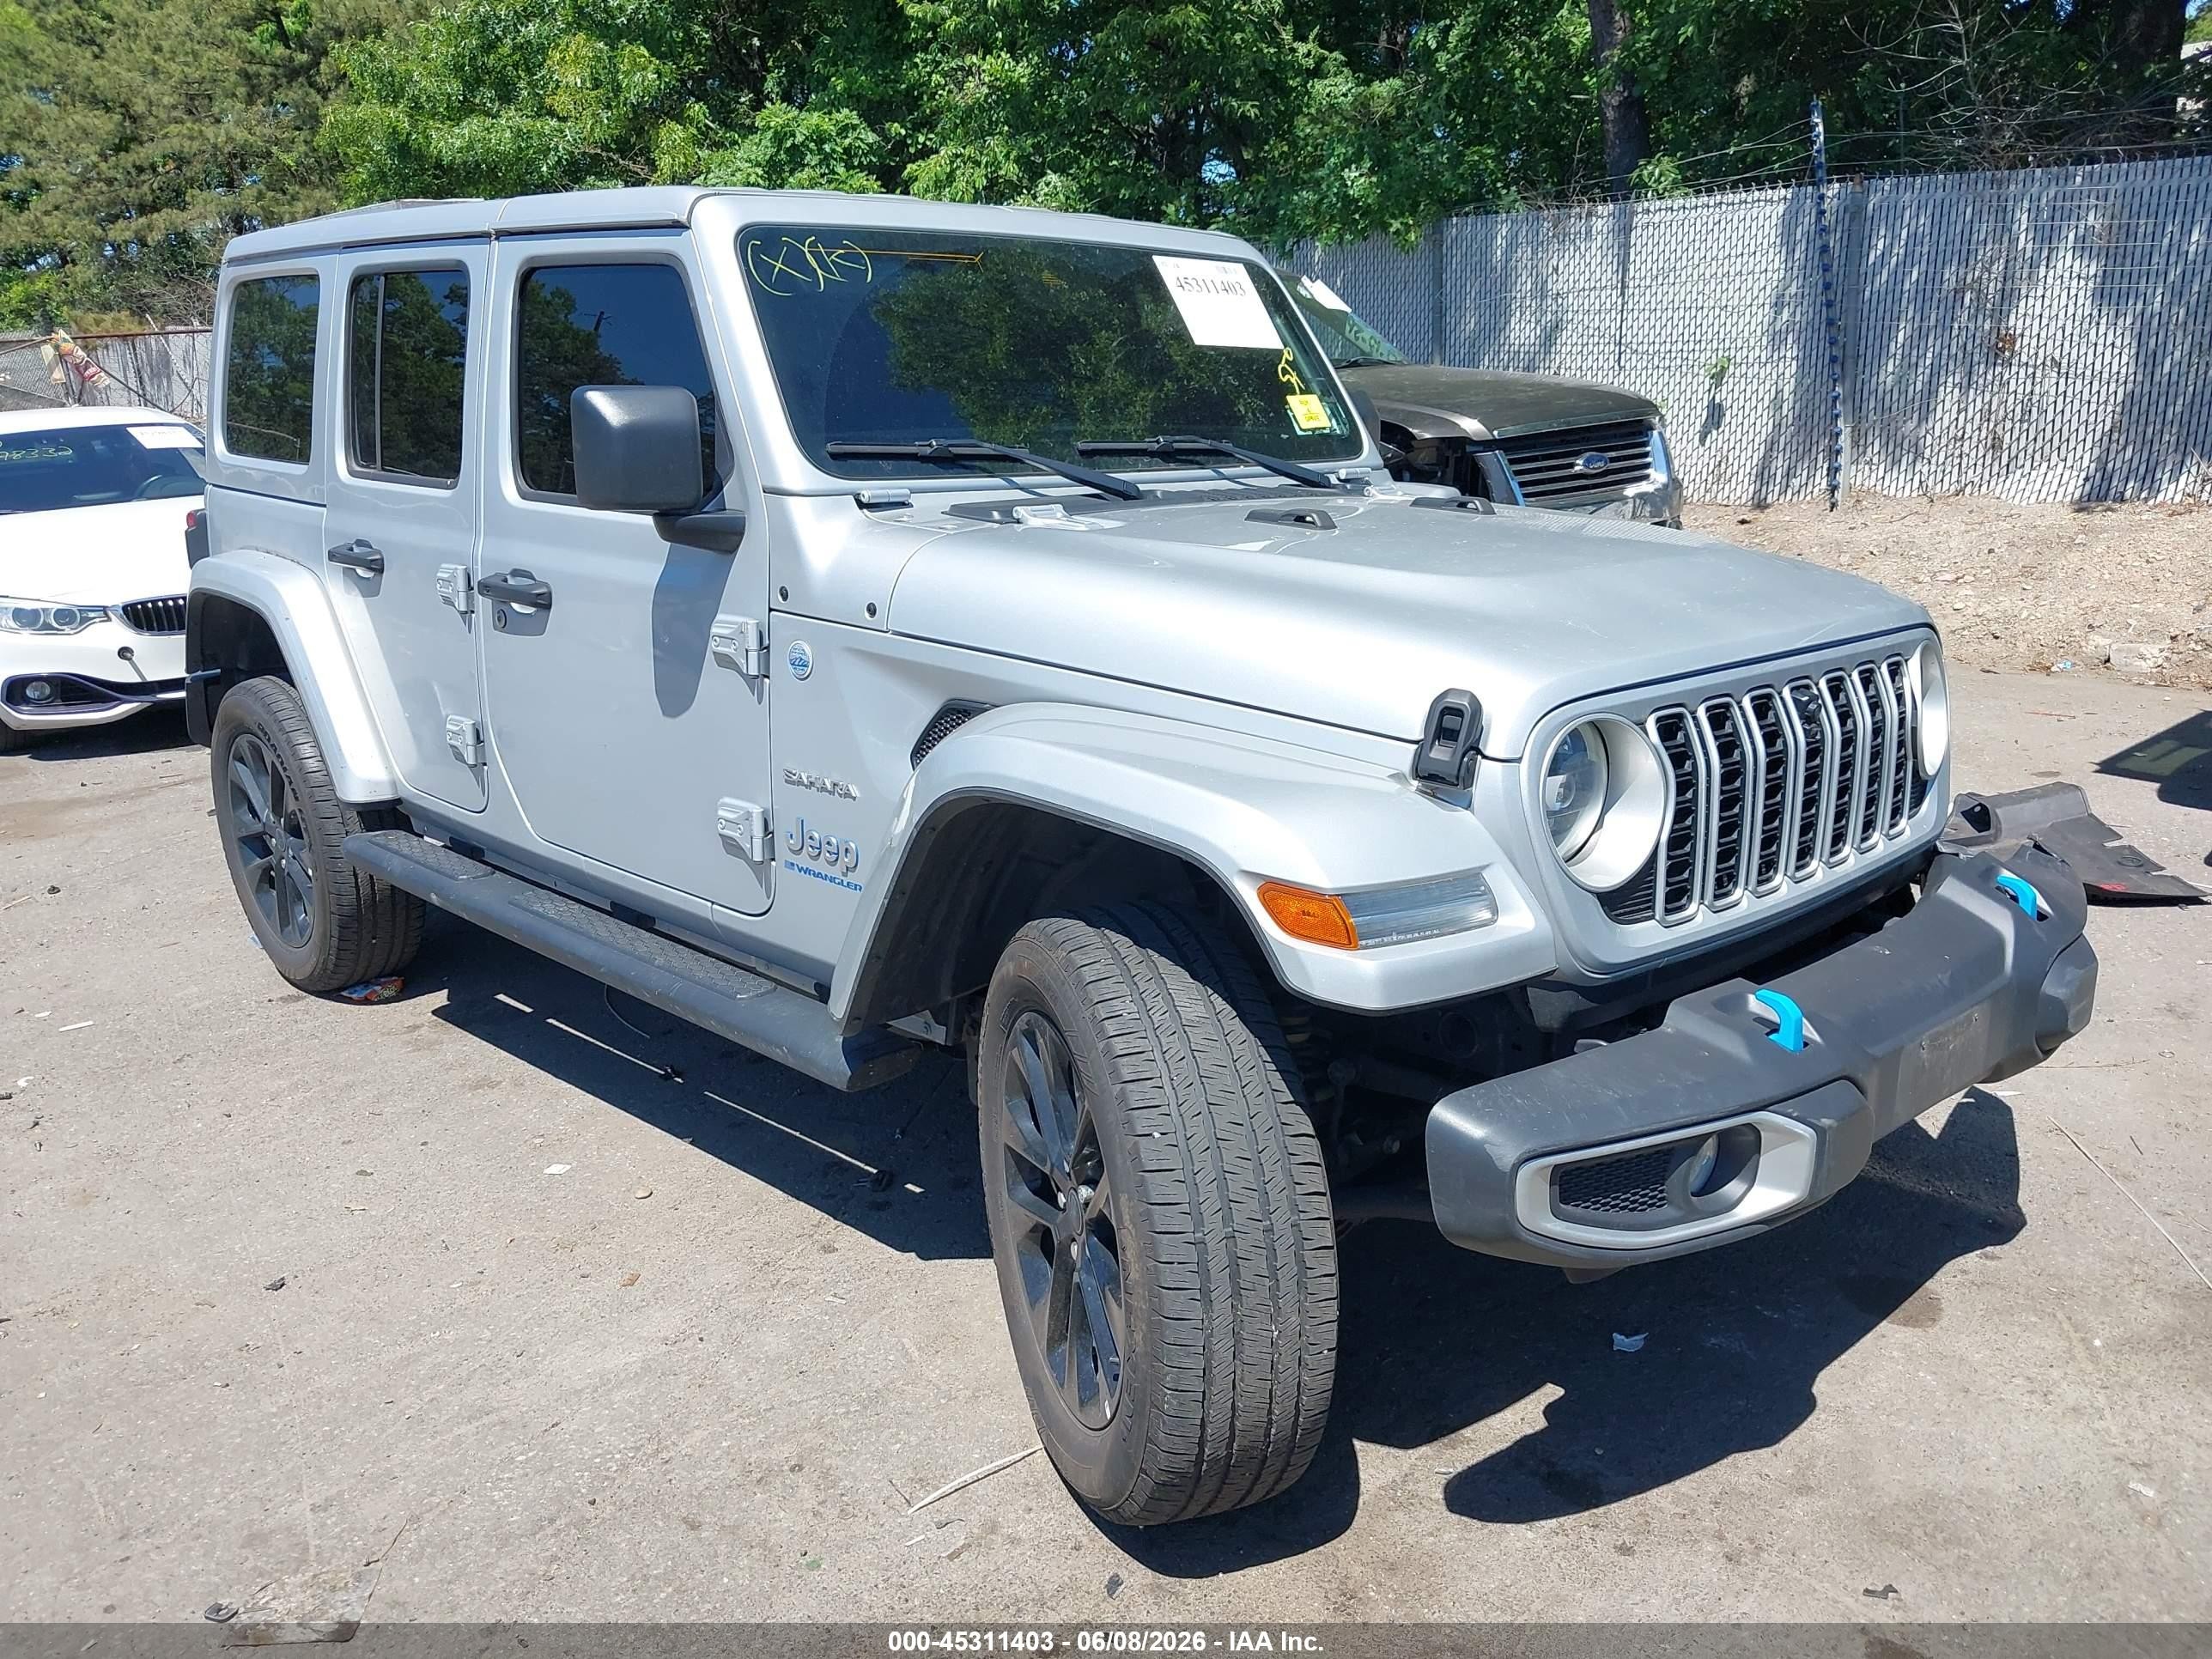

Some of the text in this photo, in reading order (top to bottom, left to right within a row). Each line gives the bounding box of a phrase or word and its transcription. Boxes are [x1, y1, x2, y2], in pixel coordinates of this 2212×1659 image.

[1176, 276, 1247, 296] 45311403
[783, 768, 860, 799] SAHARA
[783, 817, 860, 877] Jeep
[795, 863, 863, 892] WRANGLER
